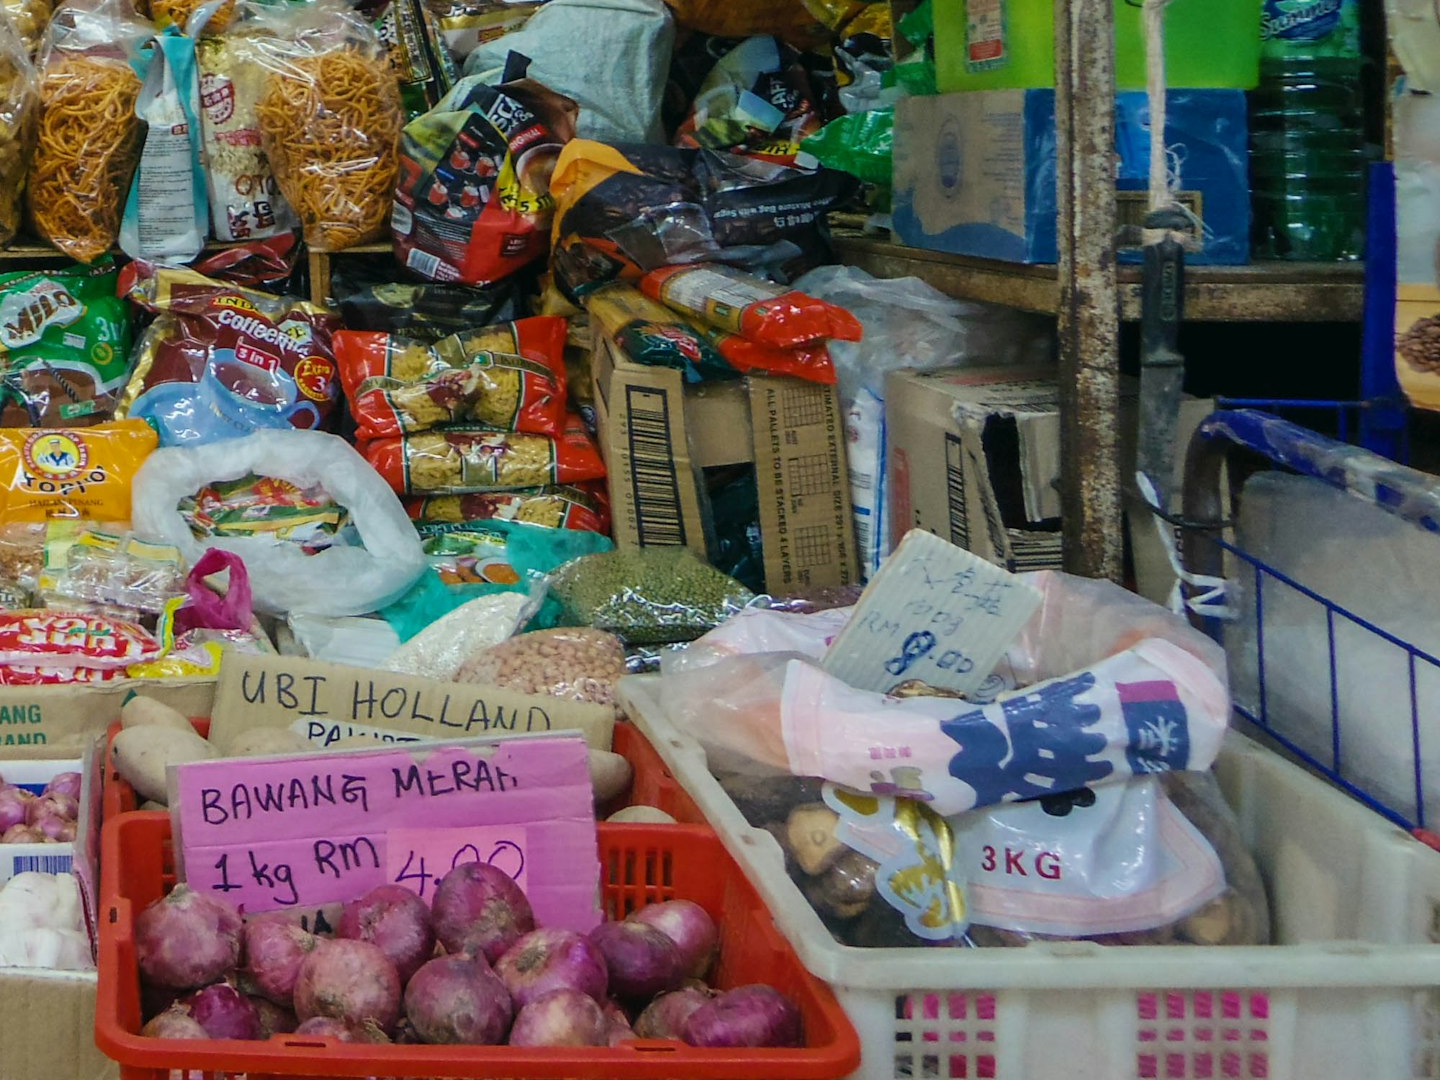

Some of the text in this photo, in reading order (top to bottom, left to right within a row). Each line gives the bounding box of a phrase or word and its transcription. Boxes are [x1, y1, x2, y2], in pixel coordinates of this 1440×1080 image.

[738, 208, 757, 217] with
[759, 205, 776, 215] Bag
[237, 348, 277, 372] 3 in 1
[301, 361, 331, 376] Extra
[313, 376, 327, 392] 3
[827, 434, 839, 487] EXTERNAL
[766, 388, 792, 585] ALL PALLETS TO BE STACKED 4 LAYERS
[832, 490, 842, 511] SIZE
[858, 610, 901, 639] RM
[242, 670, 552, 732] UBI HOLLAND
[202, 775, 369, 826] BAWANG
[251, 853, 296, 905] kg
[314, 835, 382, 880] RM
